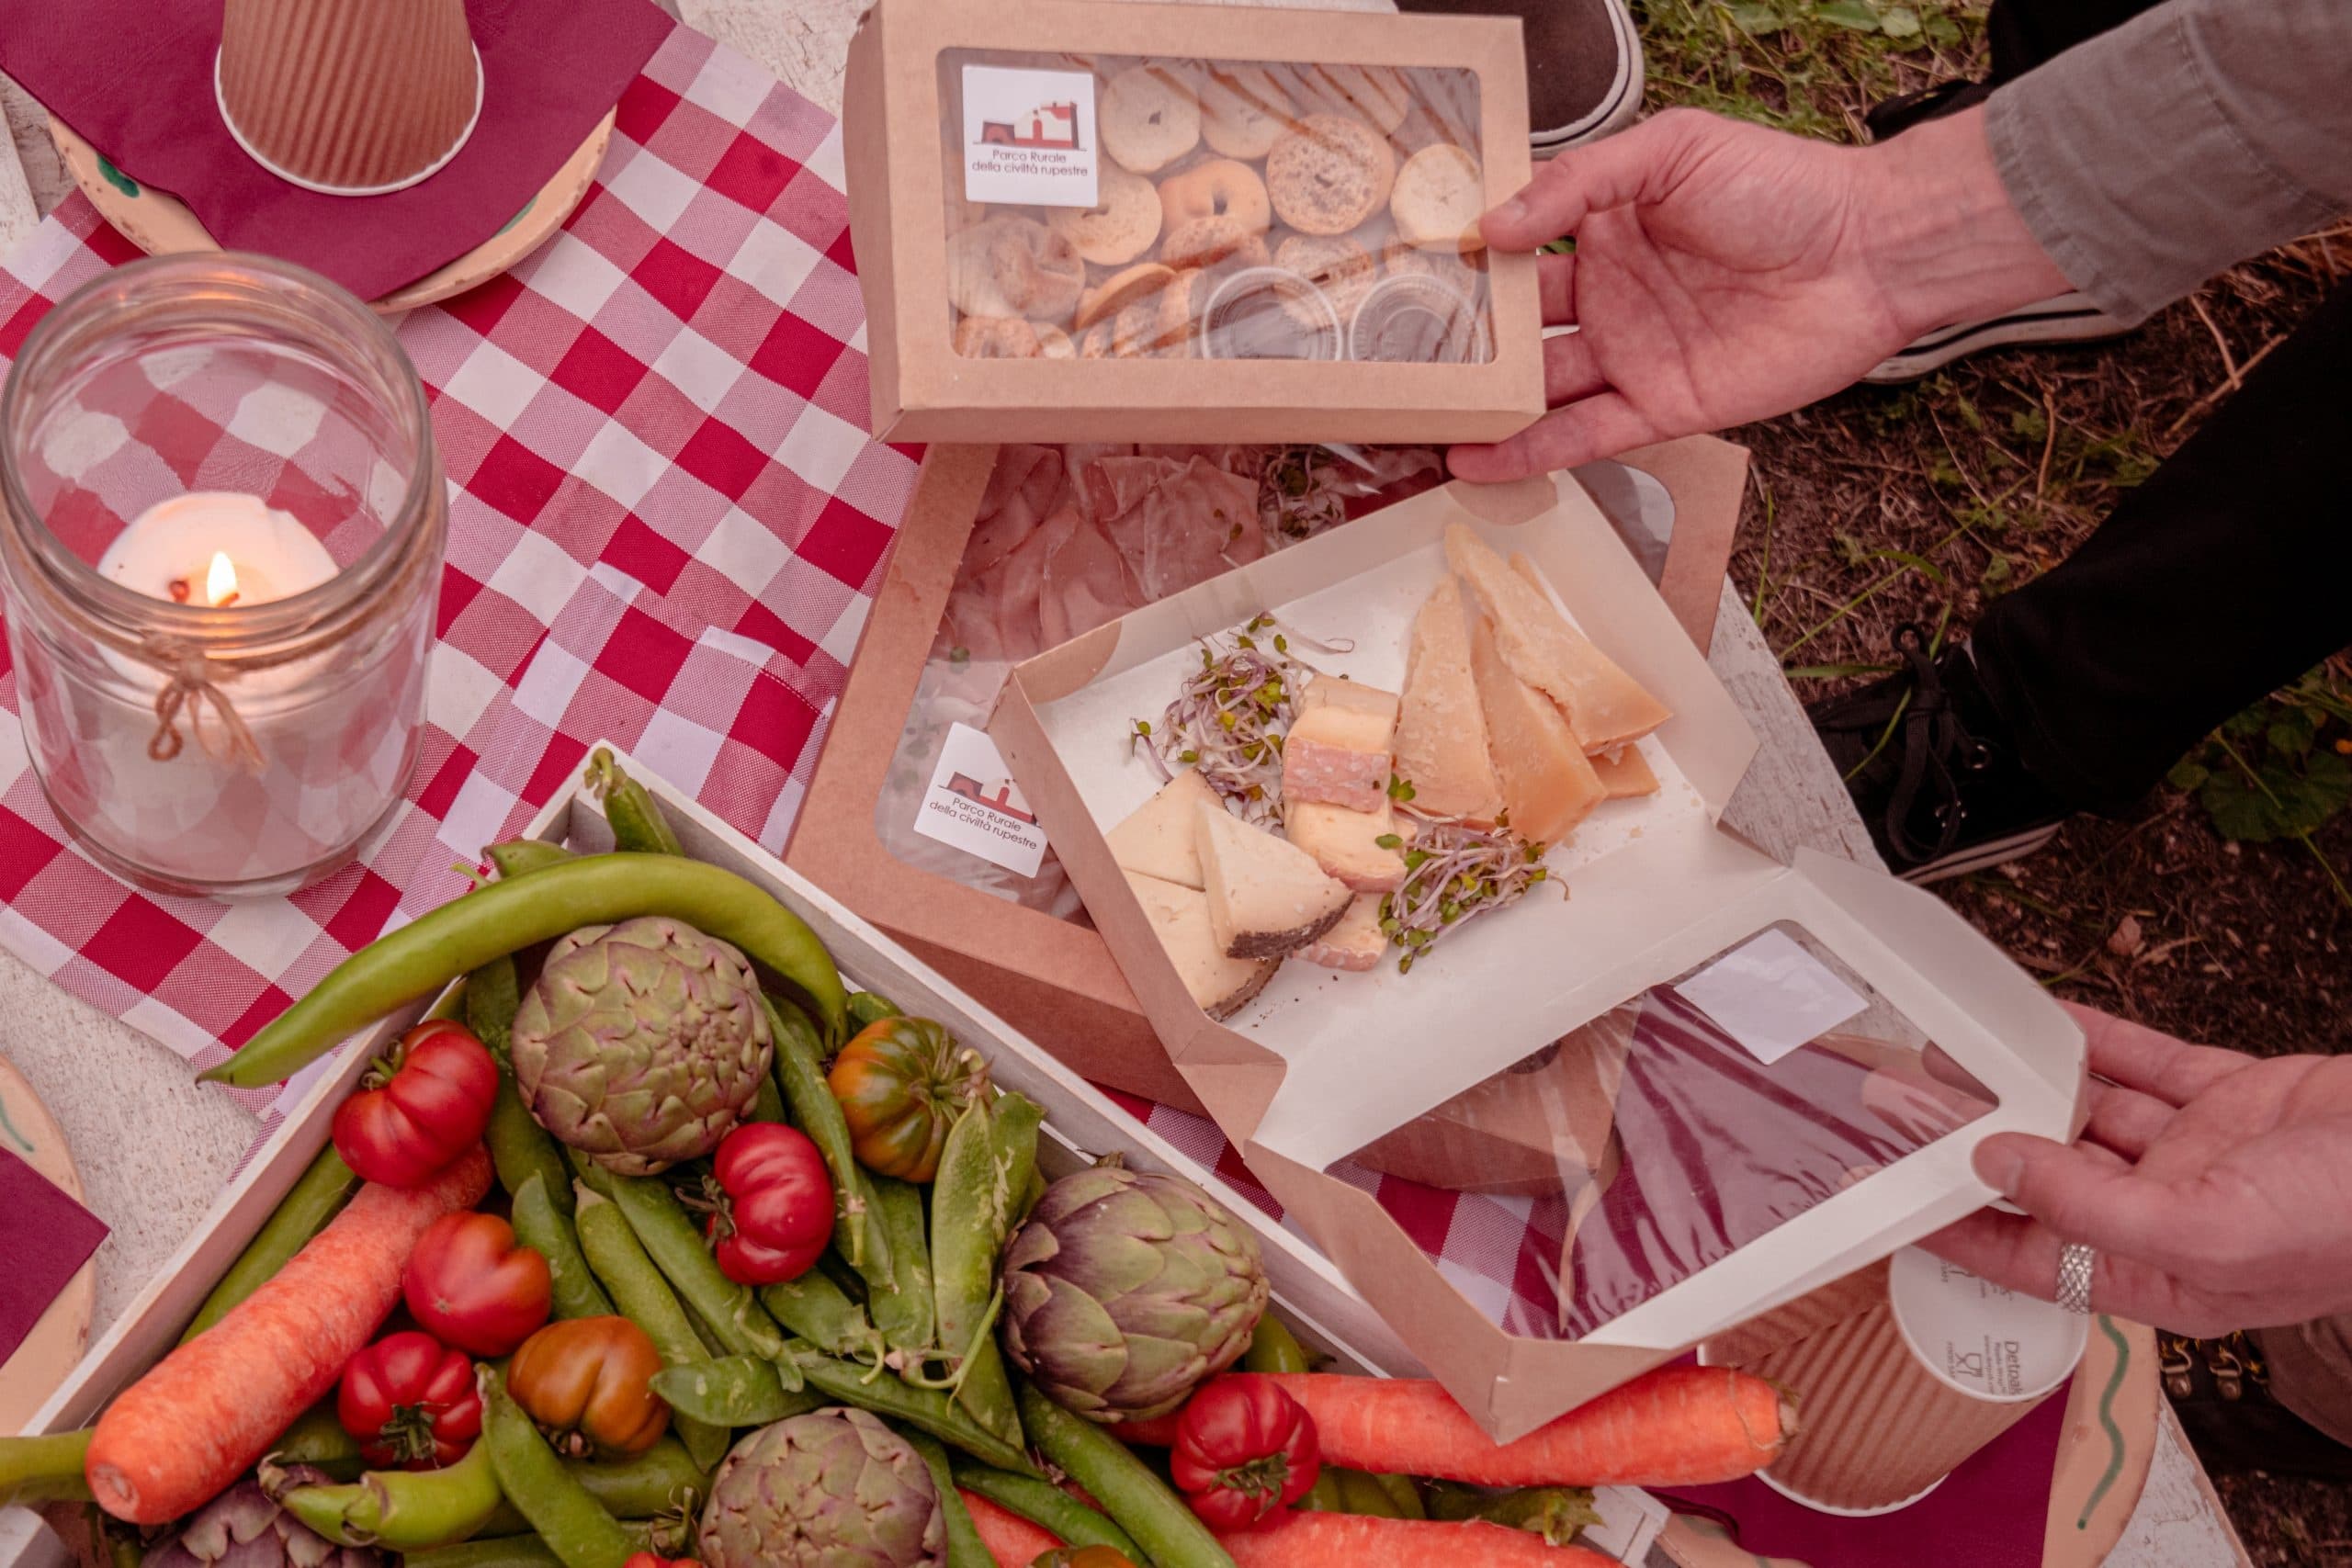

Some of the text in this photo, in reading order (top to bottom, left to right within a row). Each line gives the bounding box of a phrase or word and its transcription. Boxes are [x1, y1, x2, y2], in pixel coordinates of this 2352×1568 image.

[972, 160, 1001, 173] della
[1041, 165, 1088, 176] rupestre
[992, 149, 1067, 164] Parco Rurale
[929, 800, 956, 818] della
[992, 826, 1037, 850] rupestre
[953, 797, 1022, 832] Parco Rurale
[2004, 1340, 2024, 1395] Detpak
